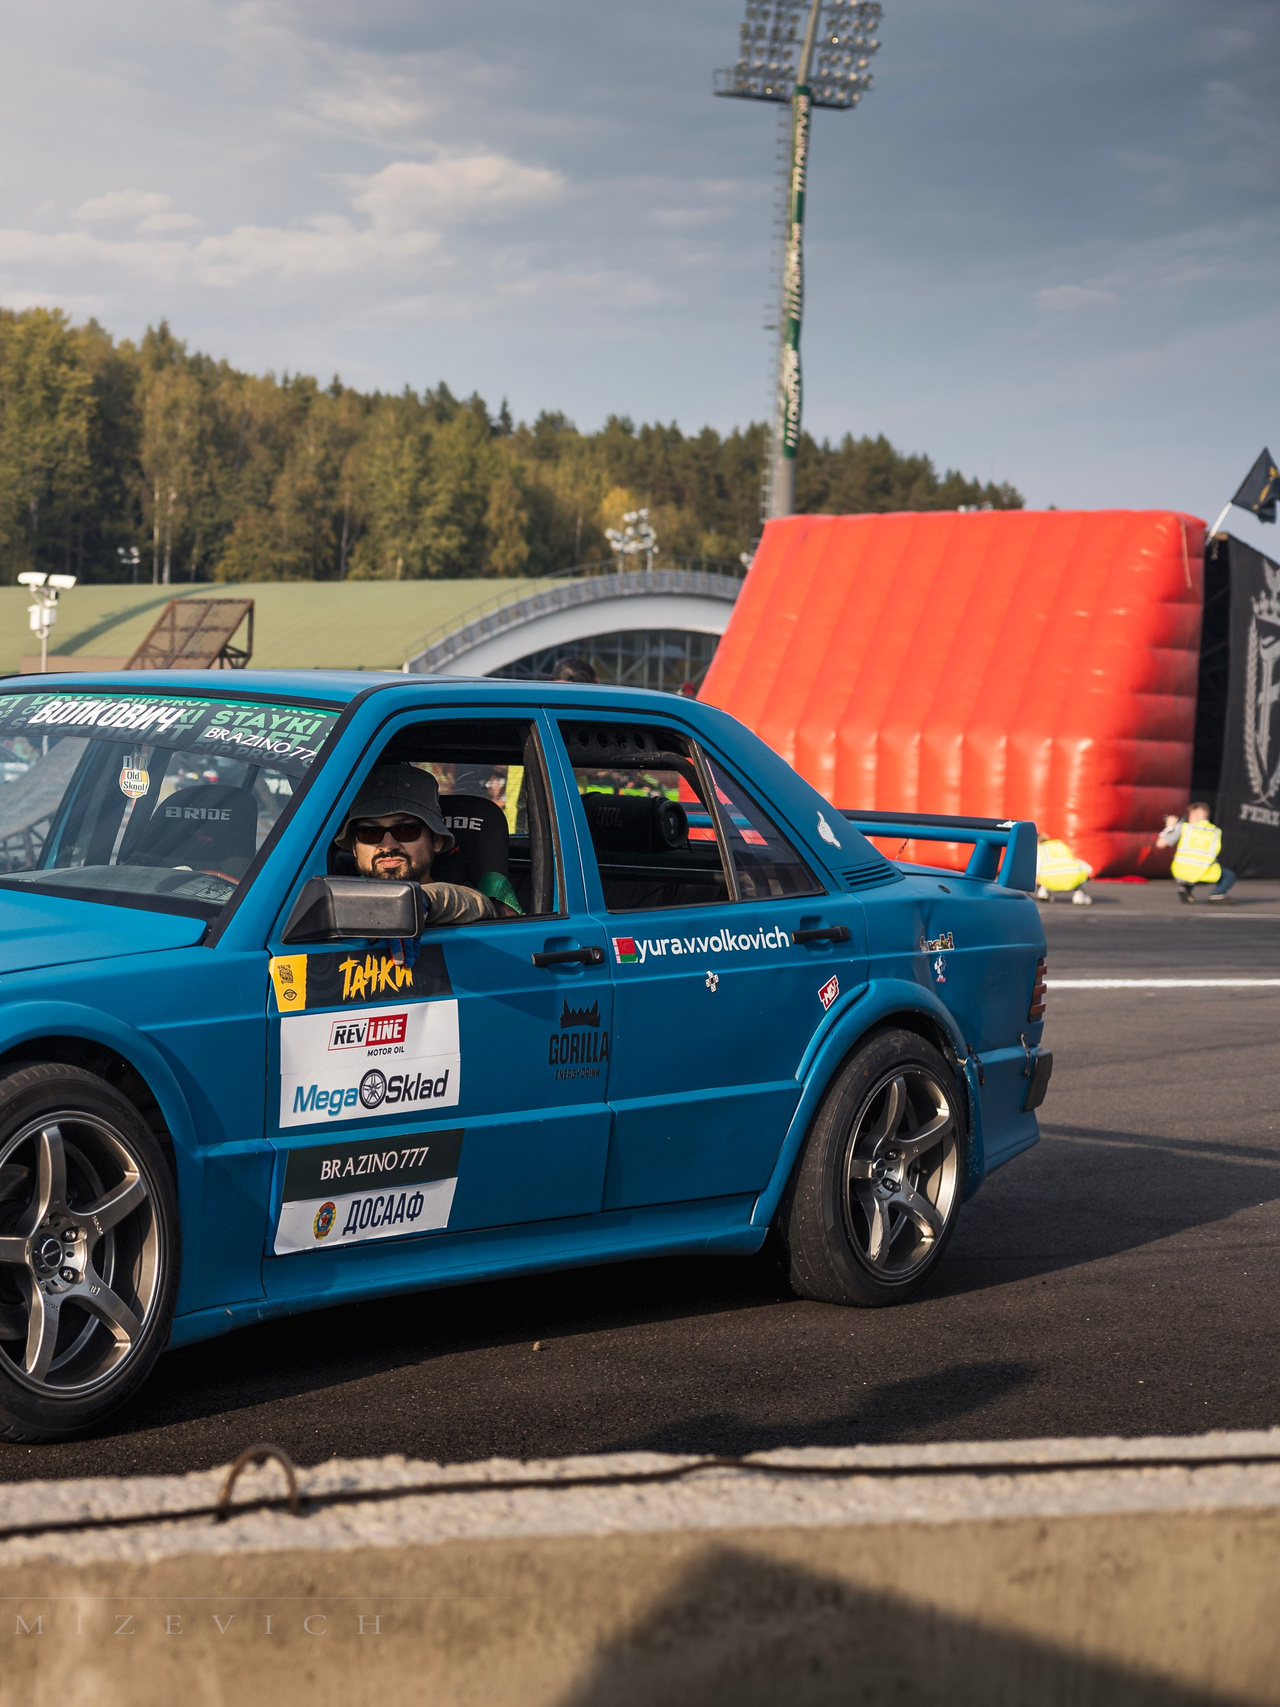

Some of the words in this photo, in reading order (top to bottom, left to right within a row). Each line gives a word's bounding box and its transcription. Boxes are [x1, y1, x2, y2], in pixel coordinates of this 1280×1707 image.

[210, 710, 322, 736] STAYKI
[204, 727, 292, 754] BRAZINO
[123, 781, 145, 791] Skool
[126, 771, 140, 780] Old
[164, 806, 233, 821] BRIDE
[635, 925, 790, 963] yura.v.volkovich
[367, 1047, 392, 1057] MOTOR
[393, 1046, 405, 1054] OIL
[548, 1031, 609, 1065] GORILLA
[554, 1069, 580, 1080] ENERGY
[581, 1067, 600, 1078] DRINK
[320, 1151, 399, 1180] BRAZINO
[400, 1147, 429, 1169] 777
[341, 1190, 425, 1236] ДОСААФ
